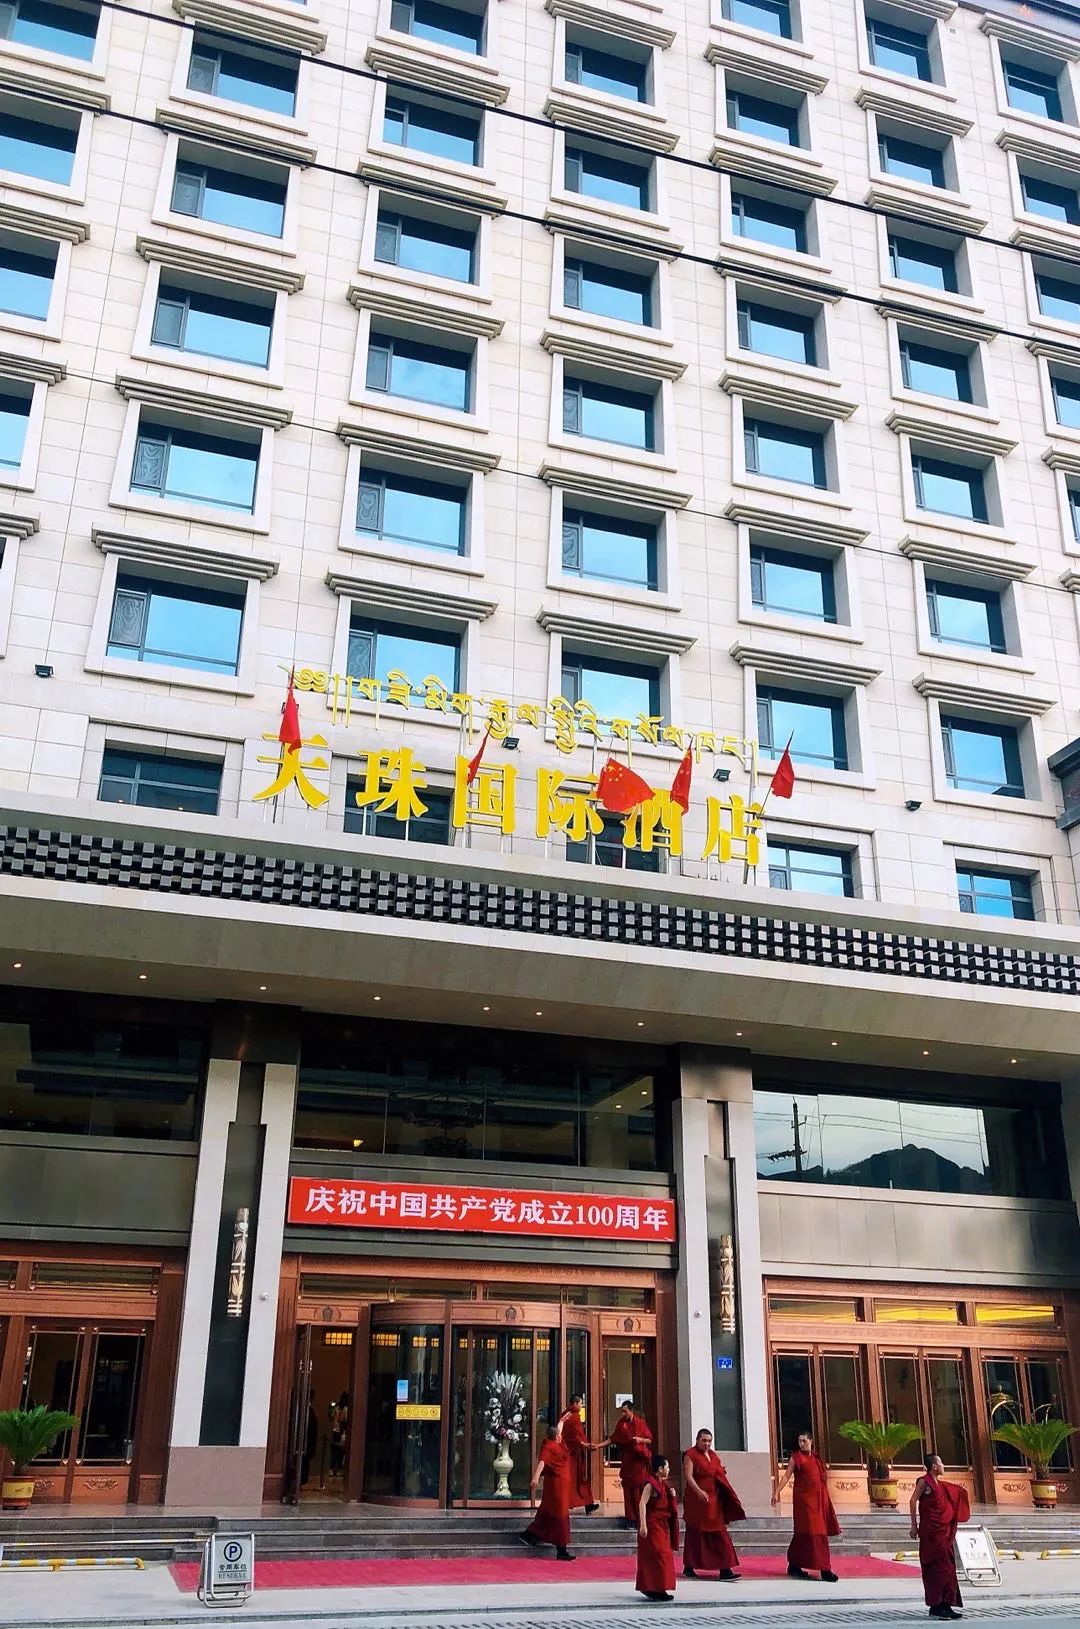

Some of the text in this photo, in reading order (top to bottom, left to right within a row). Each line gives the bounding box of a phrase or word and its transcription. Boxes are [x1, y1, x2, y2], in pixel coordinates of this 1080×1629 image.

[252, 733, 765, 866] 天珠国际酒店
[305, 1186, 669, 1231] 庆祝中国共产党成立100周年
[229, 1545, 238, 1559] P
